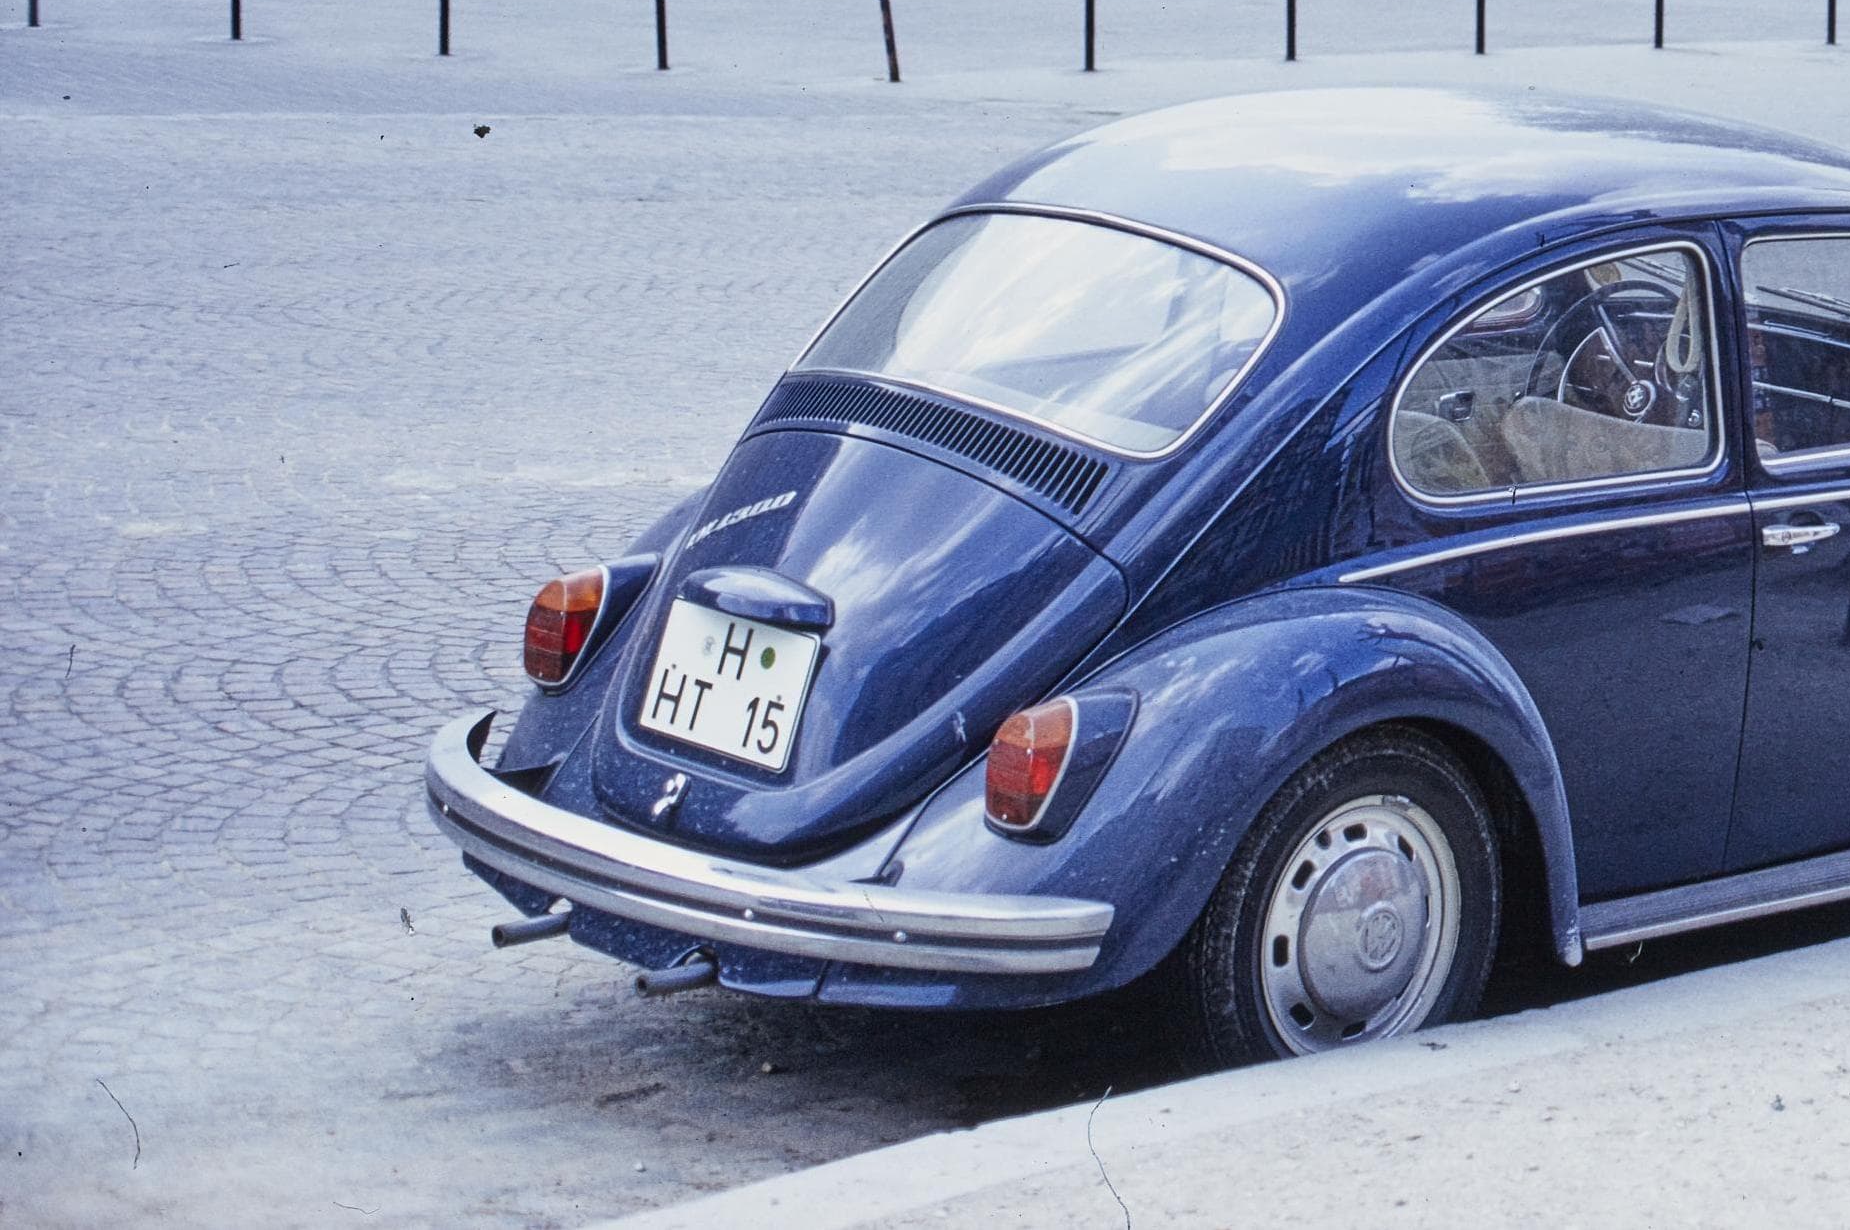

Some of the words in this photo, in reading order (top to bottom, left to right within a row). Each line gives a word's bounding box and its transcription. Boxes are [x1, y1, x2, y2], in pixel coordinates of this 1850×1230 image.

[717, 621, 754, 681] H
[652, 668, 713, 731] HT
[742, 696, 785, 754] 15
